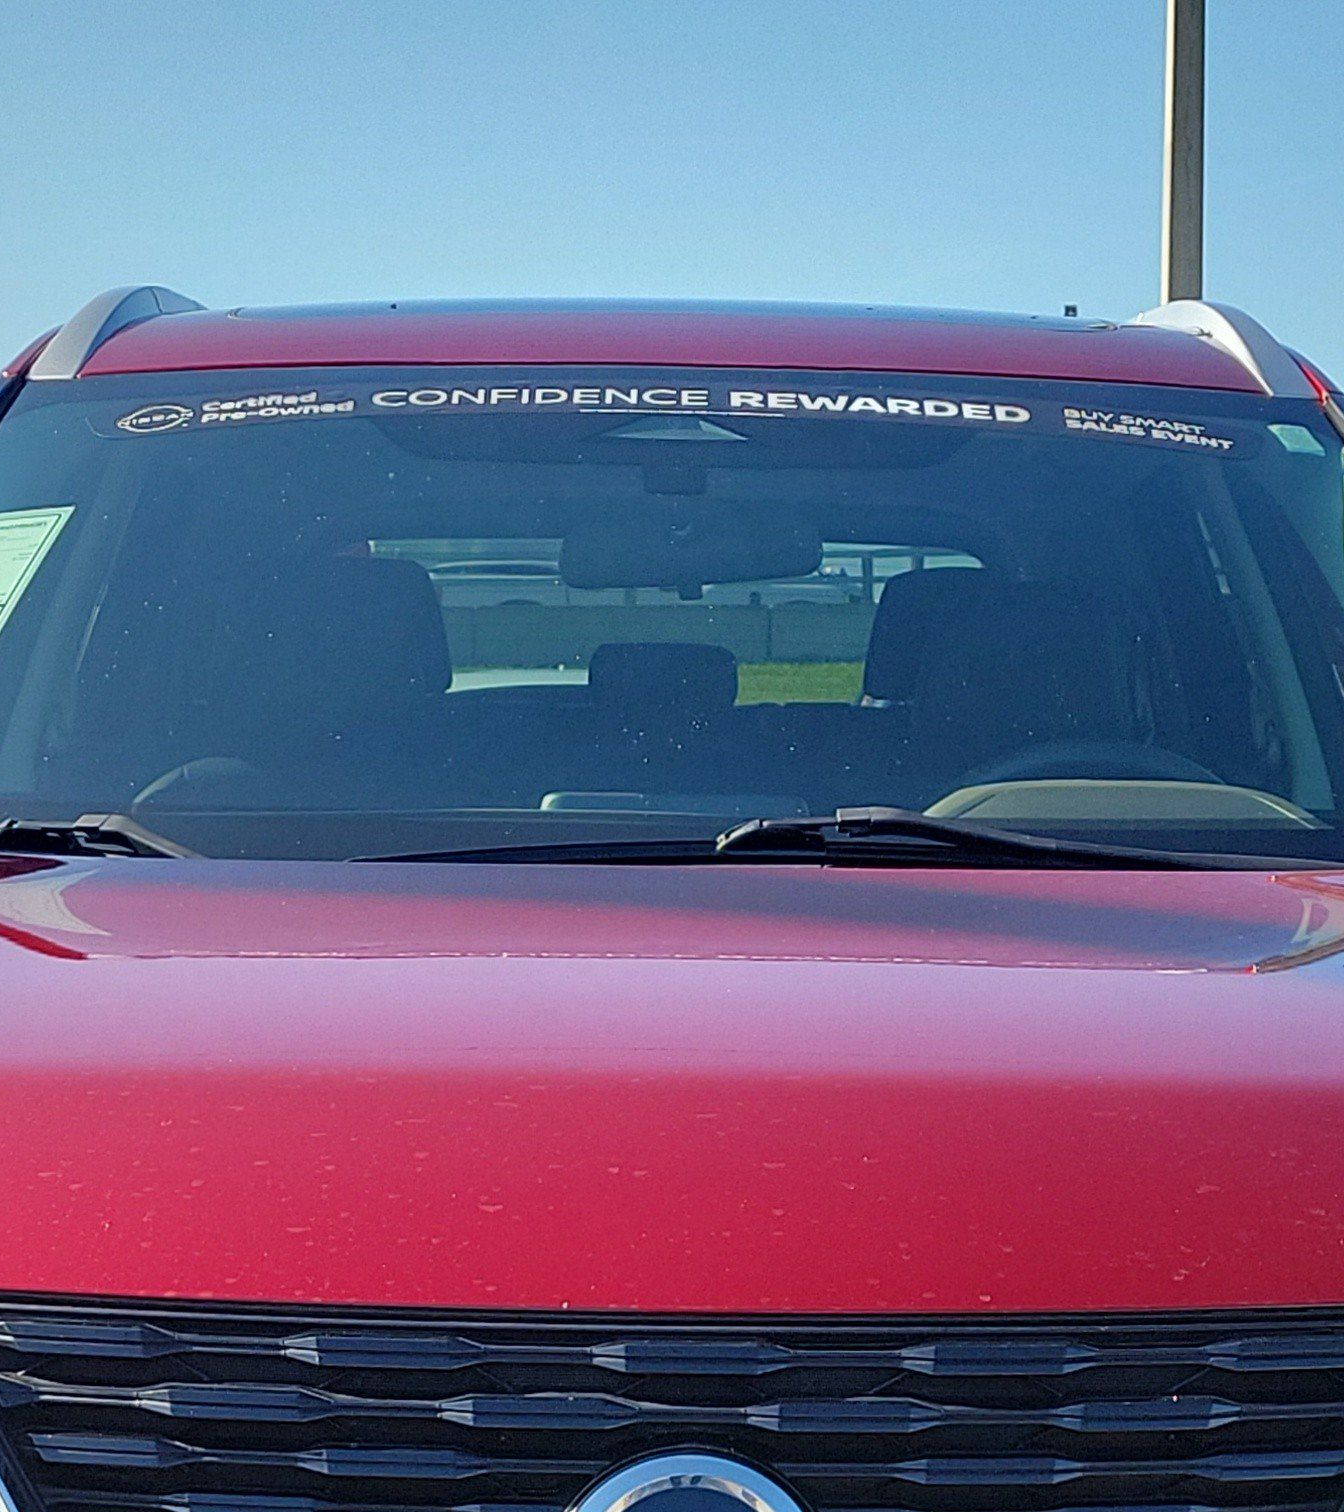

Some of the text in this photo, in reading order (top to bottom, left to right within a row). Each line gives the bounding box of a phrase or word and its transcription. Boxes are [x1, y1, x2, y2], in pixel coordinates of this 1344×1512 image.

[201, 401, 355, 423] Pre-Owned
[202, 392, 317, 411] Certified
[371, 388, 1031, 423] CONFIDENCE REWARDED
[1063, 407, 1206, 434] BUY SMART
[1065, 418, 1234, 449] SALES EVENT
